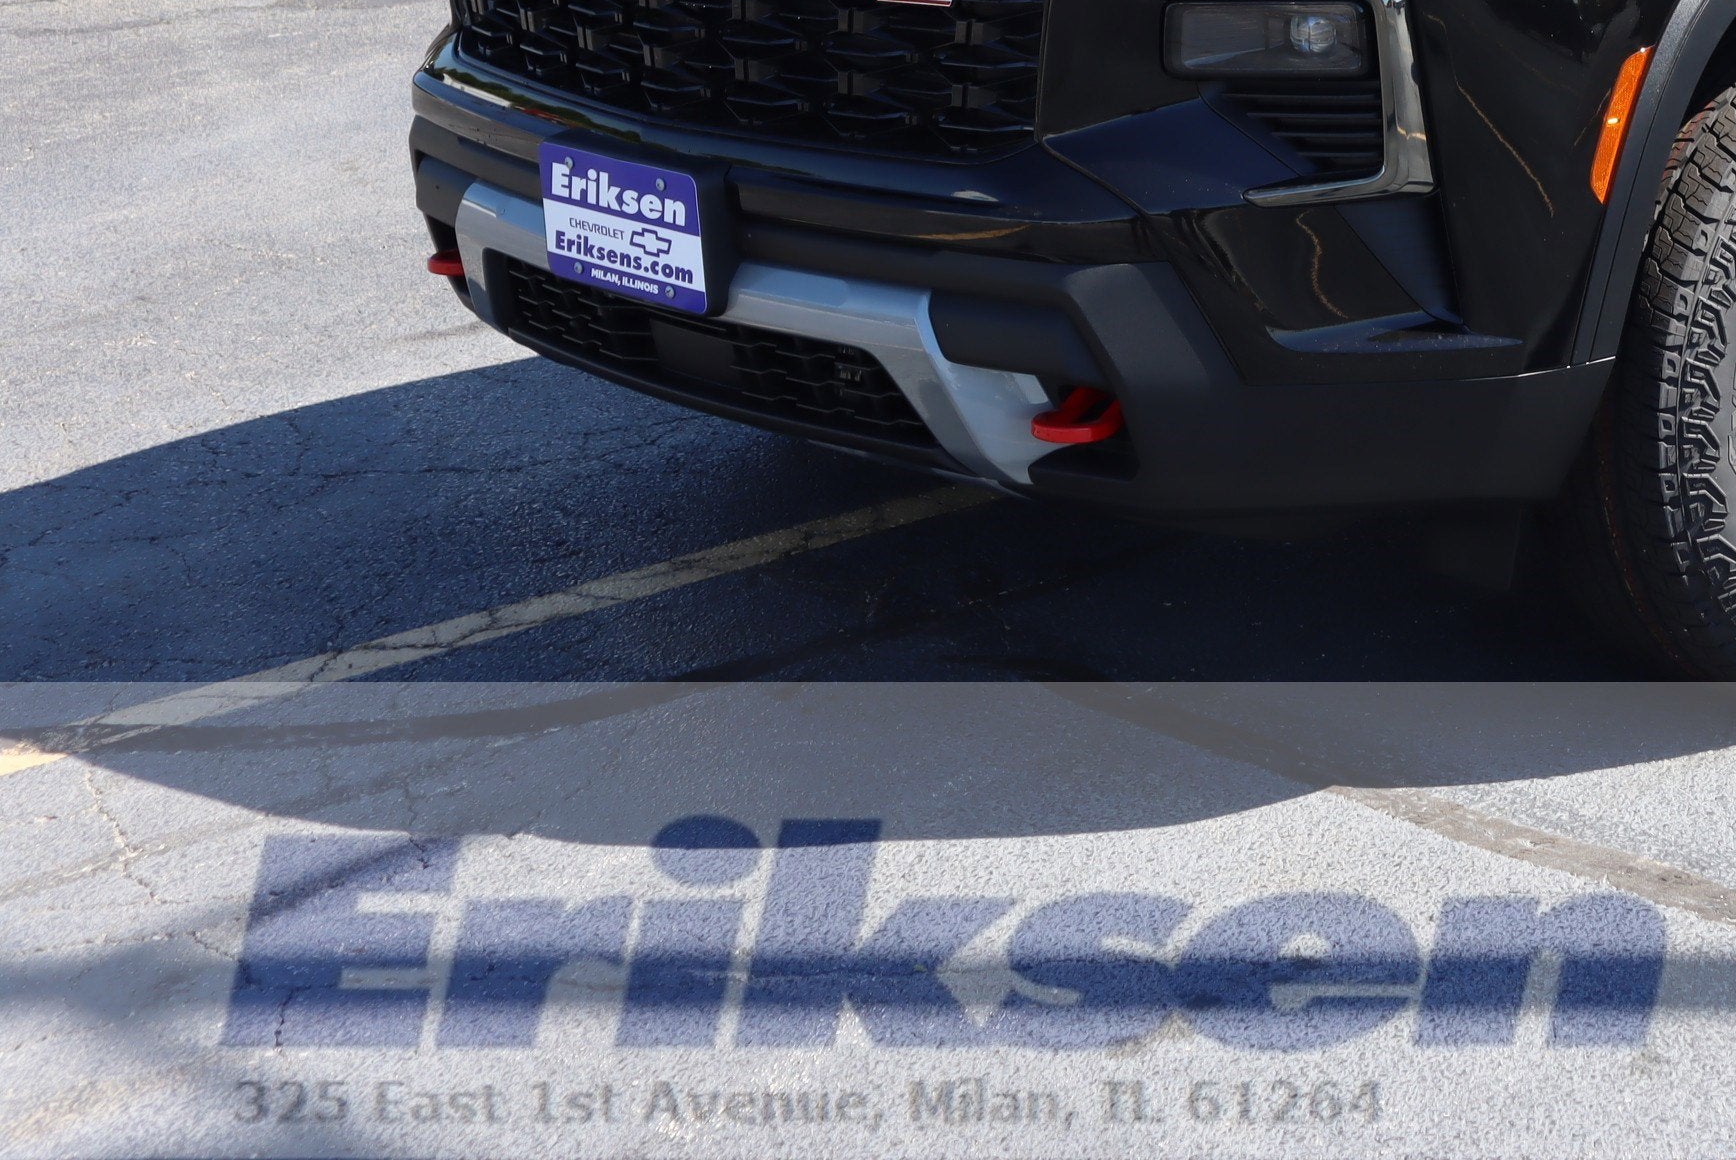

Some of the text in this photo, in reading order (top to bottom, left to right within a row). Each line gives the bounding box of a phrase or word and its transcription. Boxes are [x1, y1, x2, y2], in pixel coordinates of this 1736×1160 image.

[551, 162, 686, 227] Eriksen
[569, 217, 625, 240] CHEVROLET
[555, 230, 693, 284] Eriksens.com
[590, 267, 659, 295] MILAN, ILLINOIS
